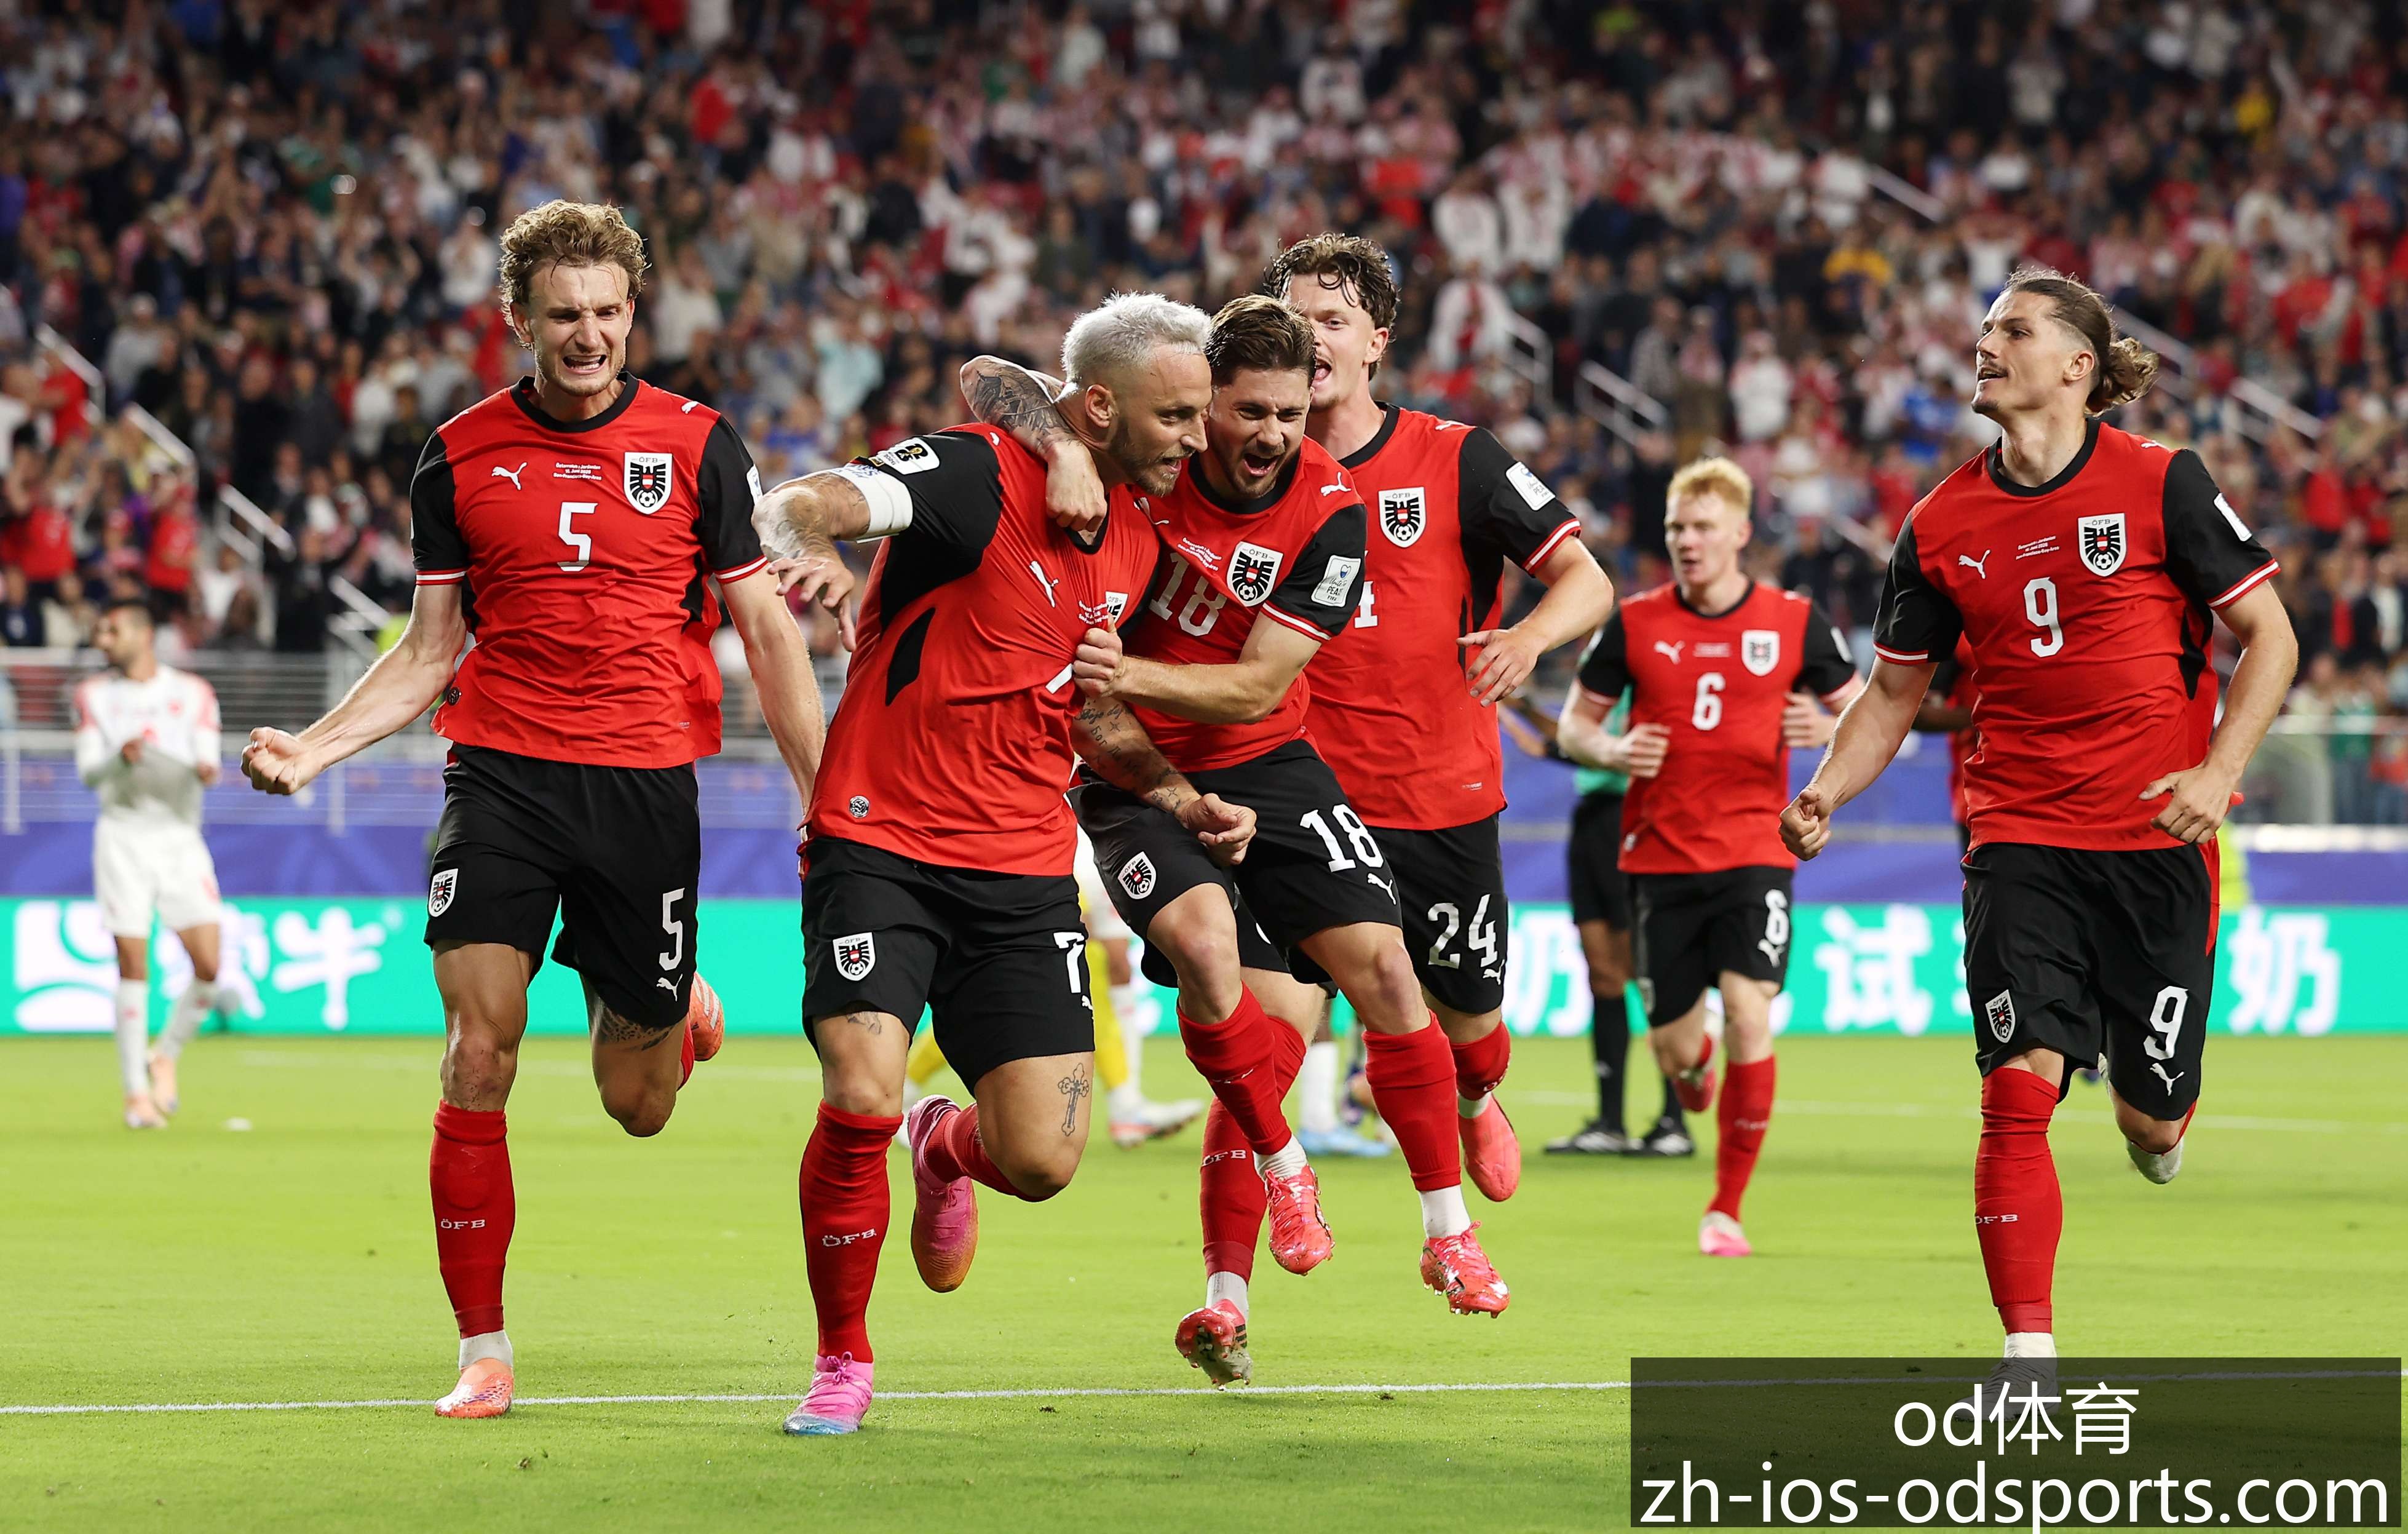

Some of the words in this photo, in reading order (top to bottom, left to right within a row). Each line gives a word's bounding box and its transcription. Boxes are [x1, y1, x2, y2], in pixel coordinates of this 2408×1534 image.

[557, 502, 598, 572] 5
[1149, 552, 1227, 637] 18
[2023, 577, 2064, 658] 9
[1692, 672, 1726, 731] 6
[1299, 803, 1384, 873] 18
[659, 888, 685, 971] 5
[1427, 894, 1498, 968] 24
[1764, 889, 1789, 945] 6
[1053, 931, 1085, 993] 7
[2144, 985, 2188, 1060] 9
[441, 1218, 485, 1230] ÖFB
[822, 1228, 877, 1247] ÖFB
